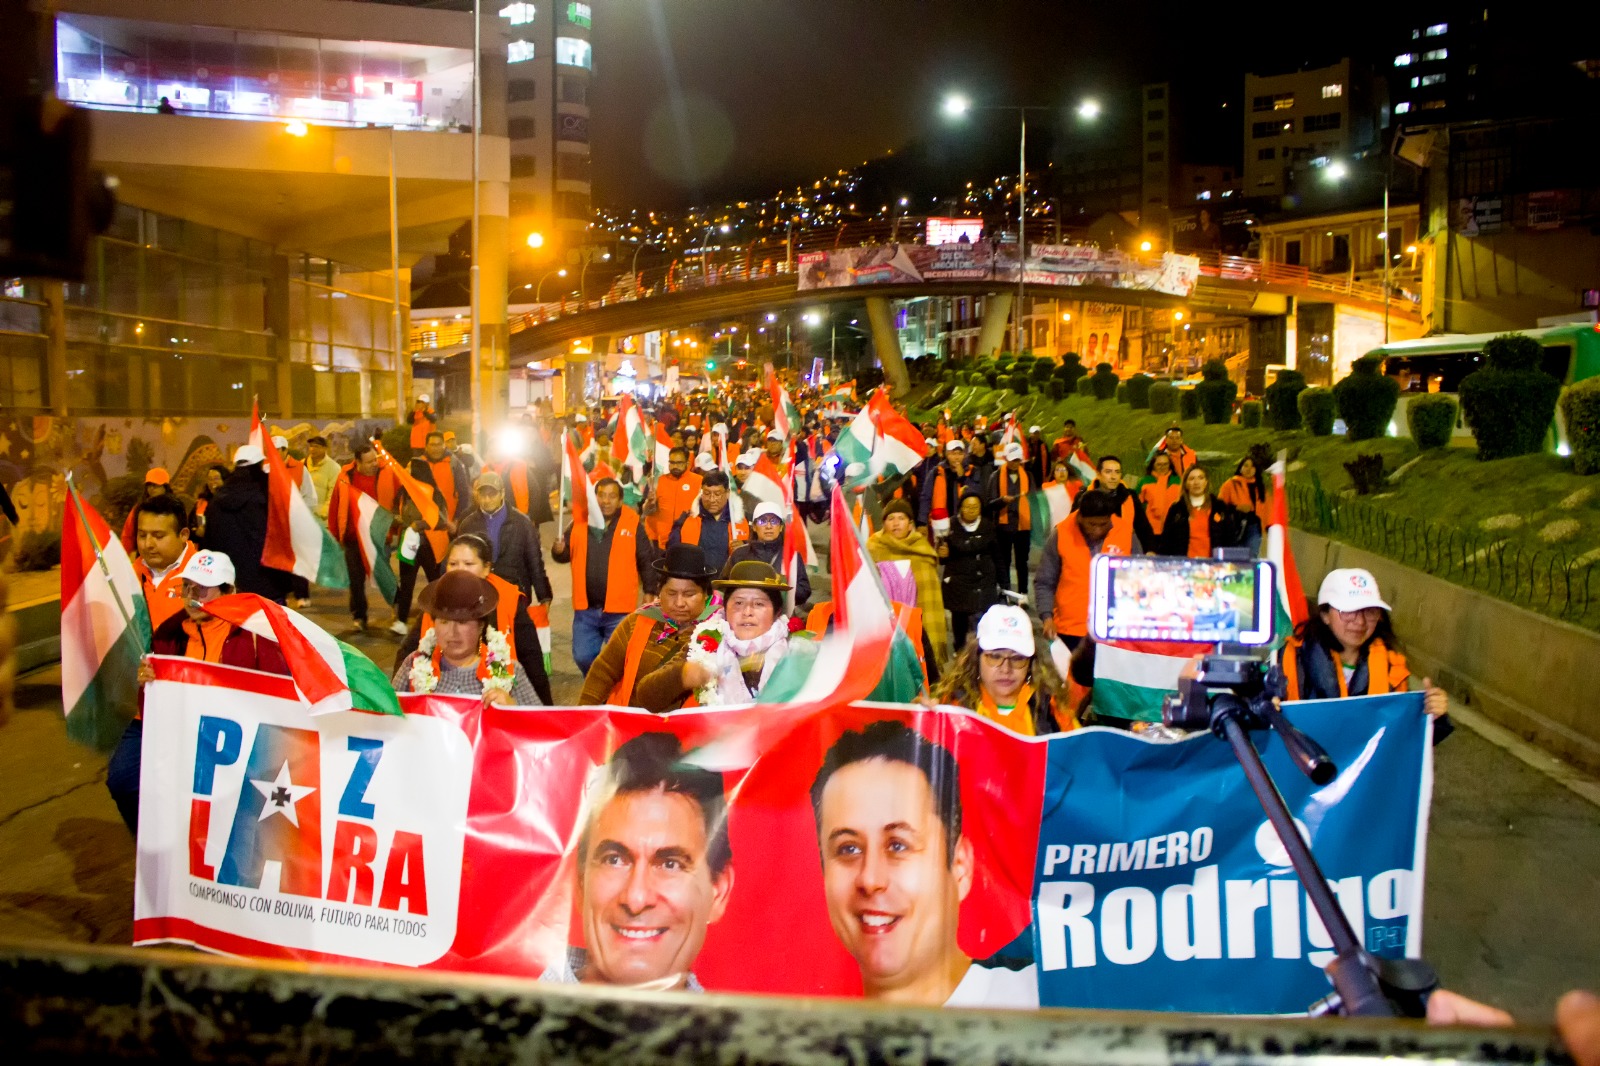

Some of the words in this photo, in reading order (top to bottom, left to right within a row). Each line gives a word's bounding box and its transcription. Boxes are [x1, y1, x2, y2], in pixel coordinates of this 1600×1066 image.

[801, 254, 824, 263] ANTES
[193, 715, 384, 820] PAZ
[189, 798, 428, 916] LARA
[1043, 826, 1214, 876] PRIMERO
[189, 881, 247, 910] COMPROMISO
[249, 895, 271, 914] CON
[274, 899, 316, 923] BOLIVIA,
[320, 907, 362, 928] FUTURO
[364, 914, 390, 933] PARA
[392, 918, 428, 938] TODOS
[1037, 818, 1413, 972] Rodrigo
